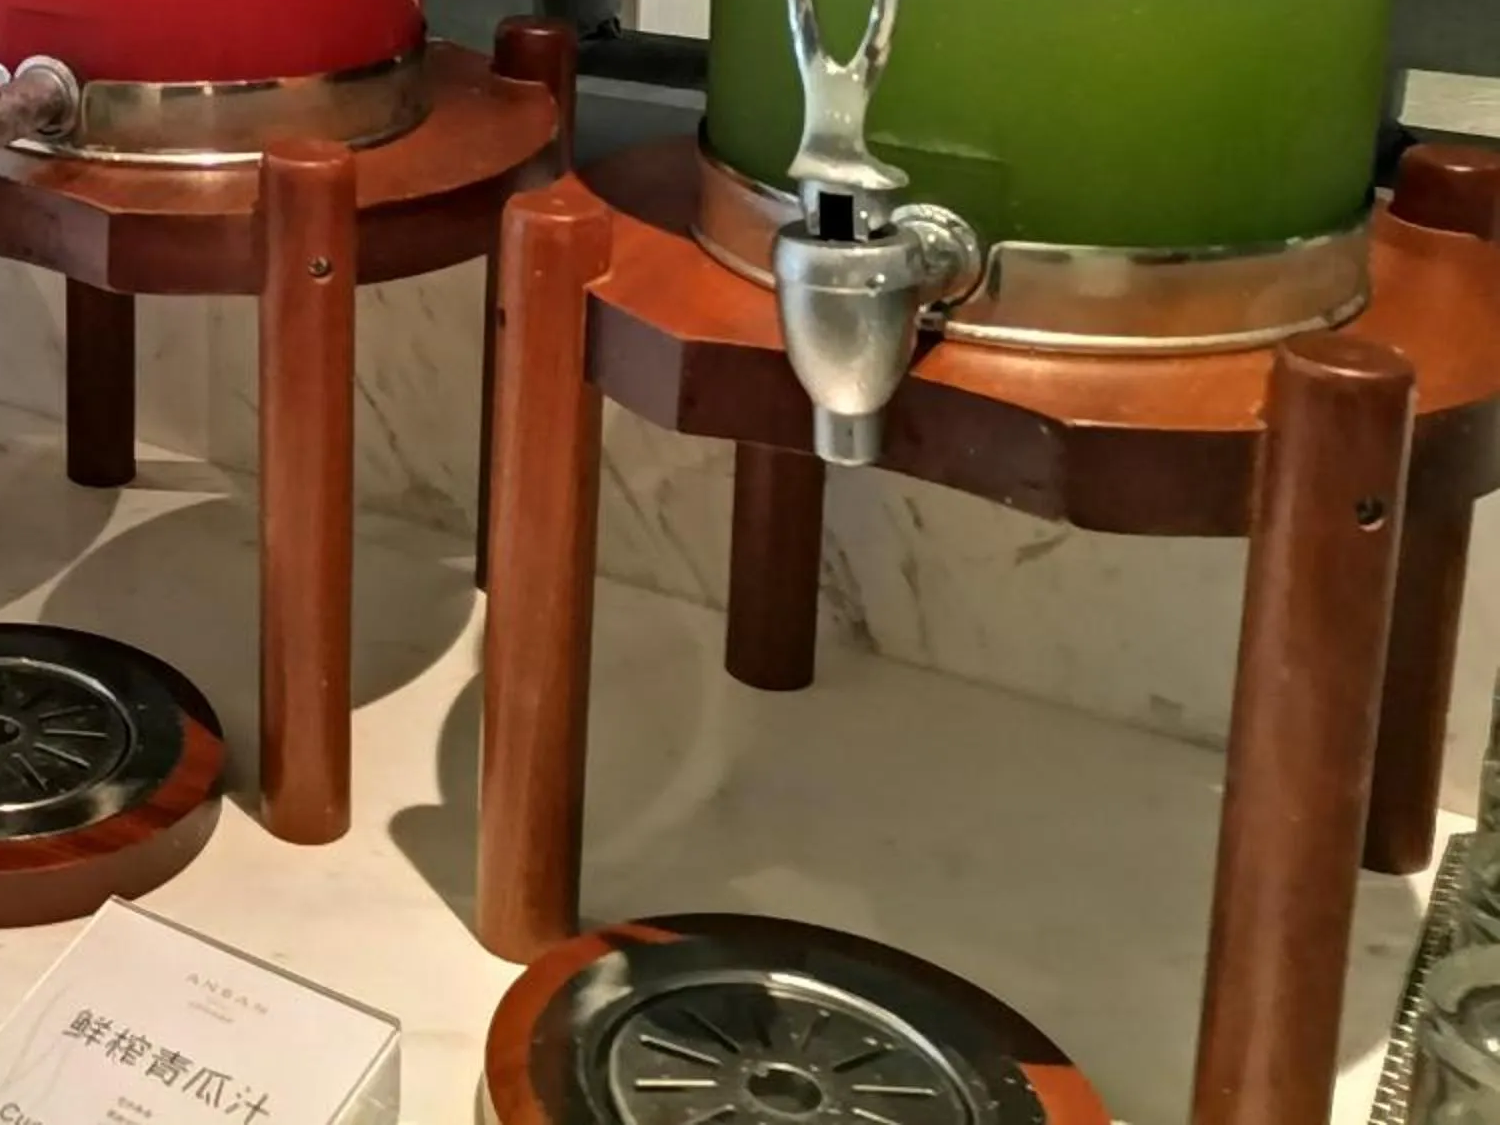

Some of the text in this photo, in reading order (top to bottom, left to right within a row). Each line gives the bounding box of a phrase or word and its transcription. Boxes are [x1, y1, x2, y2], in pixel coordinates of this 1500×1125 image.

[61, 1007, 271, 1125] 鲜榨青瓜汁
